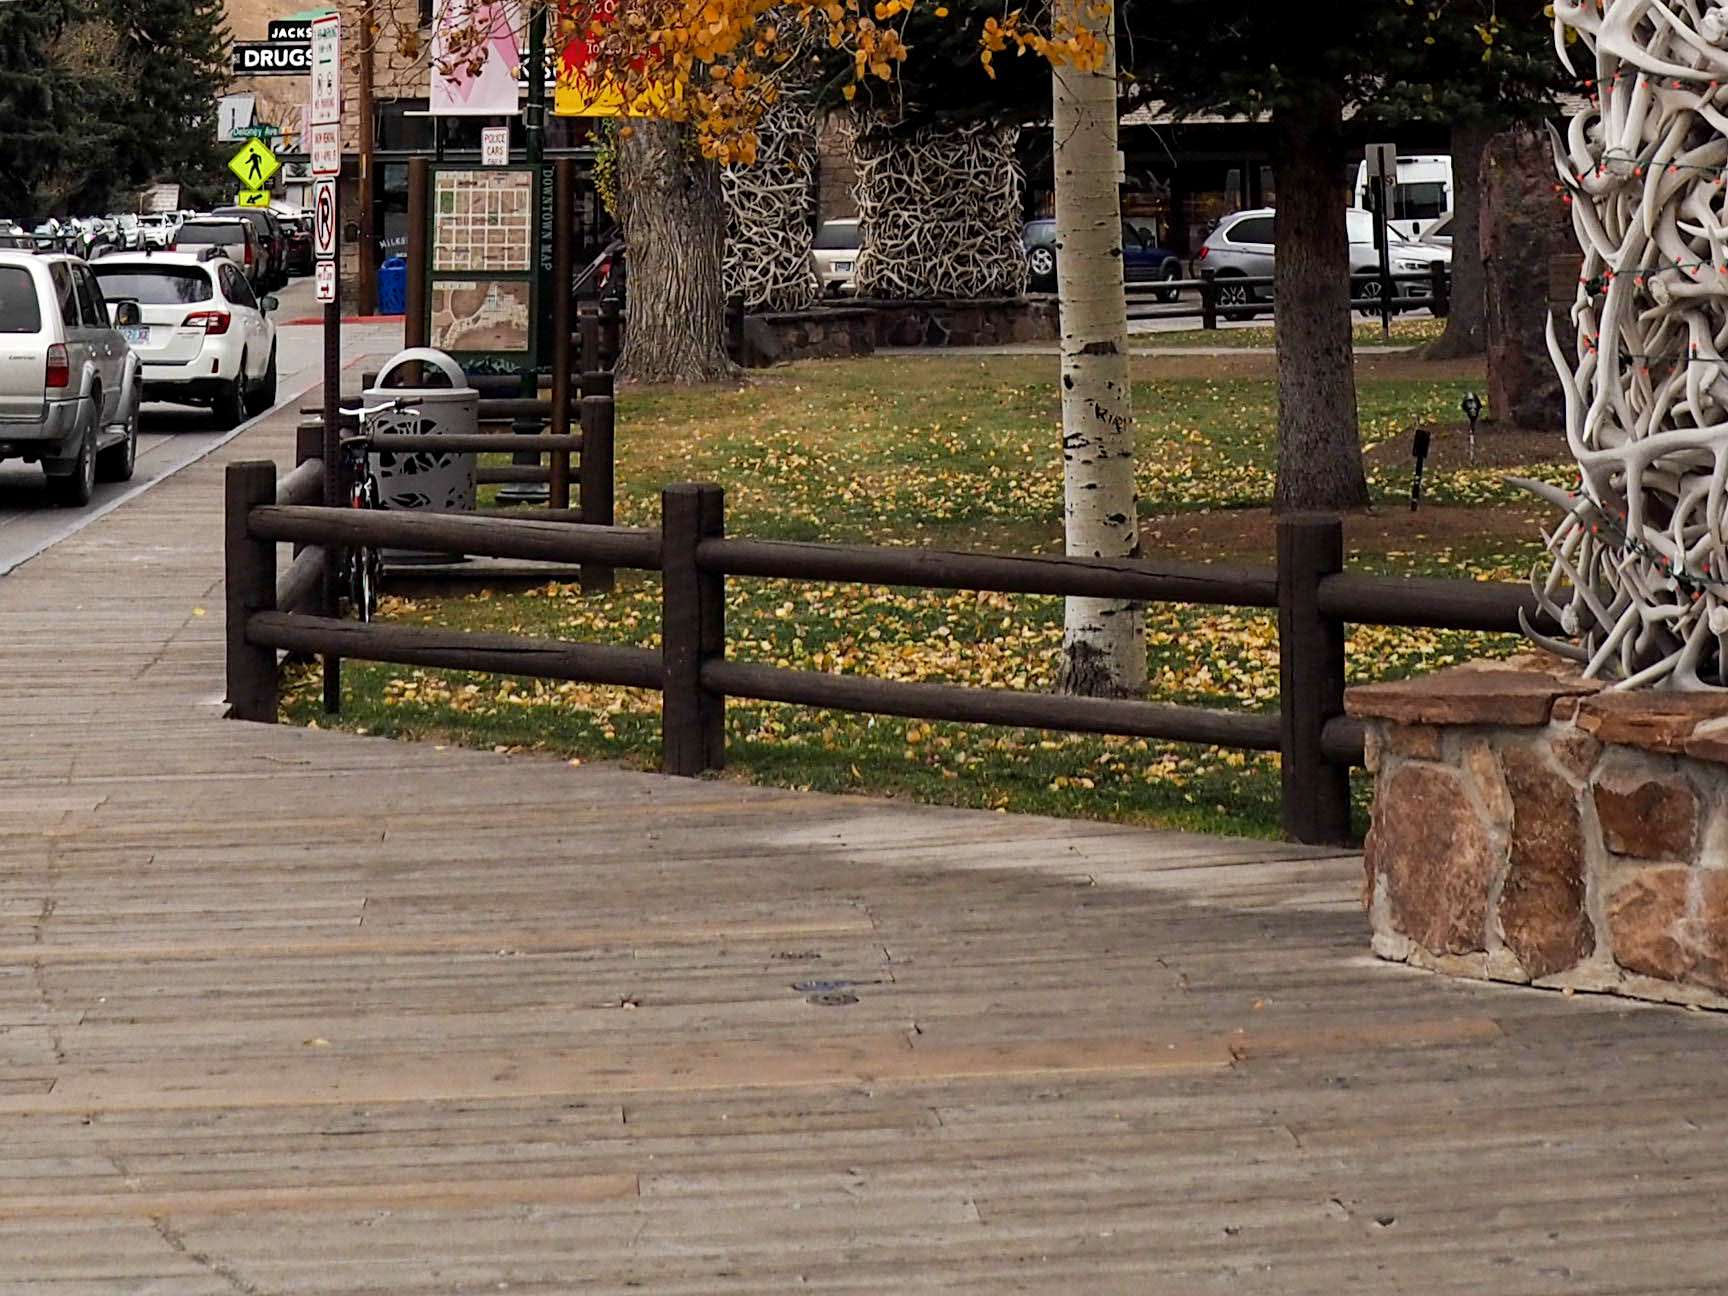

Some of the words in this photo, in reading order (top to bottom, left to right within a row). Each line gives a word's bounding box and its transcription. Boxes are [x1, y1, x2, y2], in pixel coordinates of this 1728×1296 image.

[272, 27, 312, 39] JACKS
[484, 134, 505, 143] POLICE
[487, 146, 504, 156] CARS
[540, 169, 554, 239] DOWNTOWN
[540, 246, 554, 272] MAP
